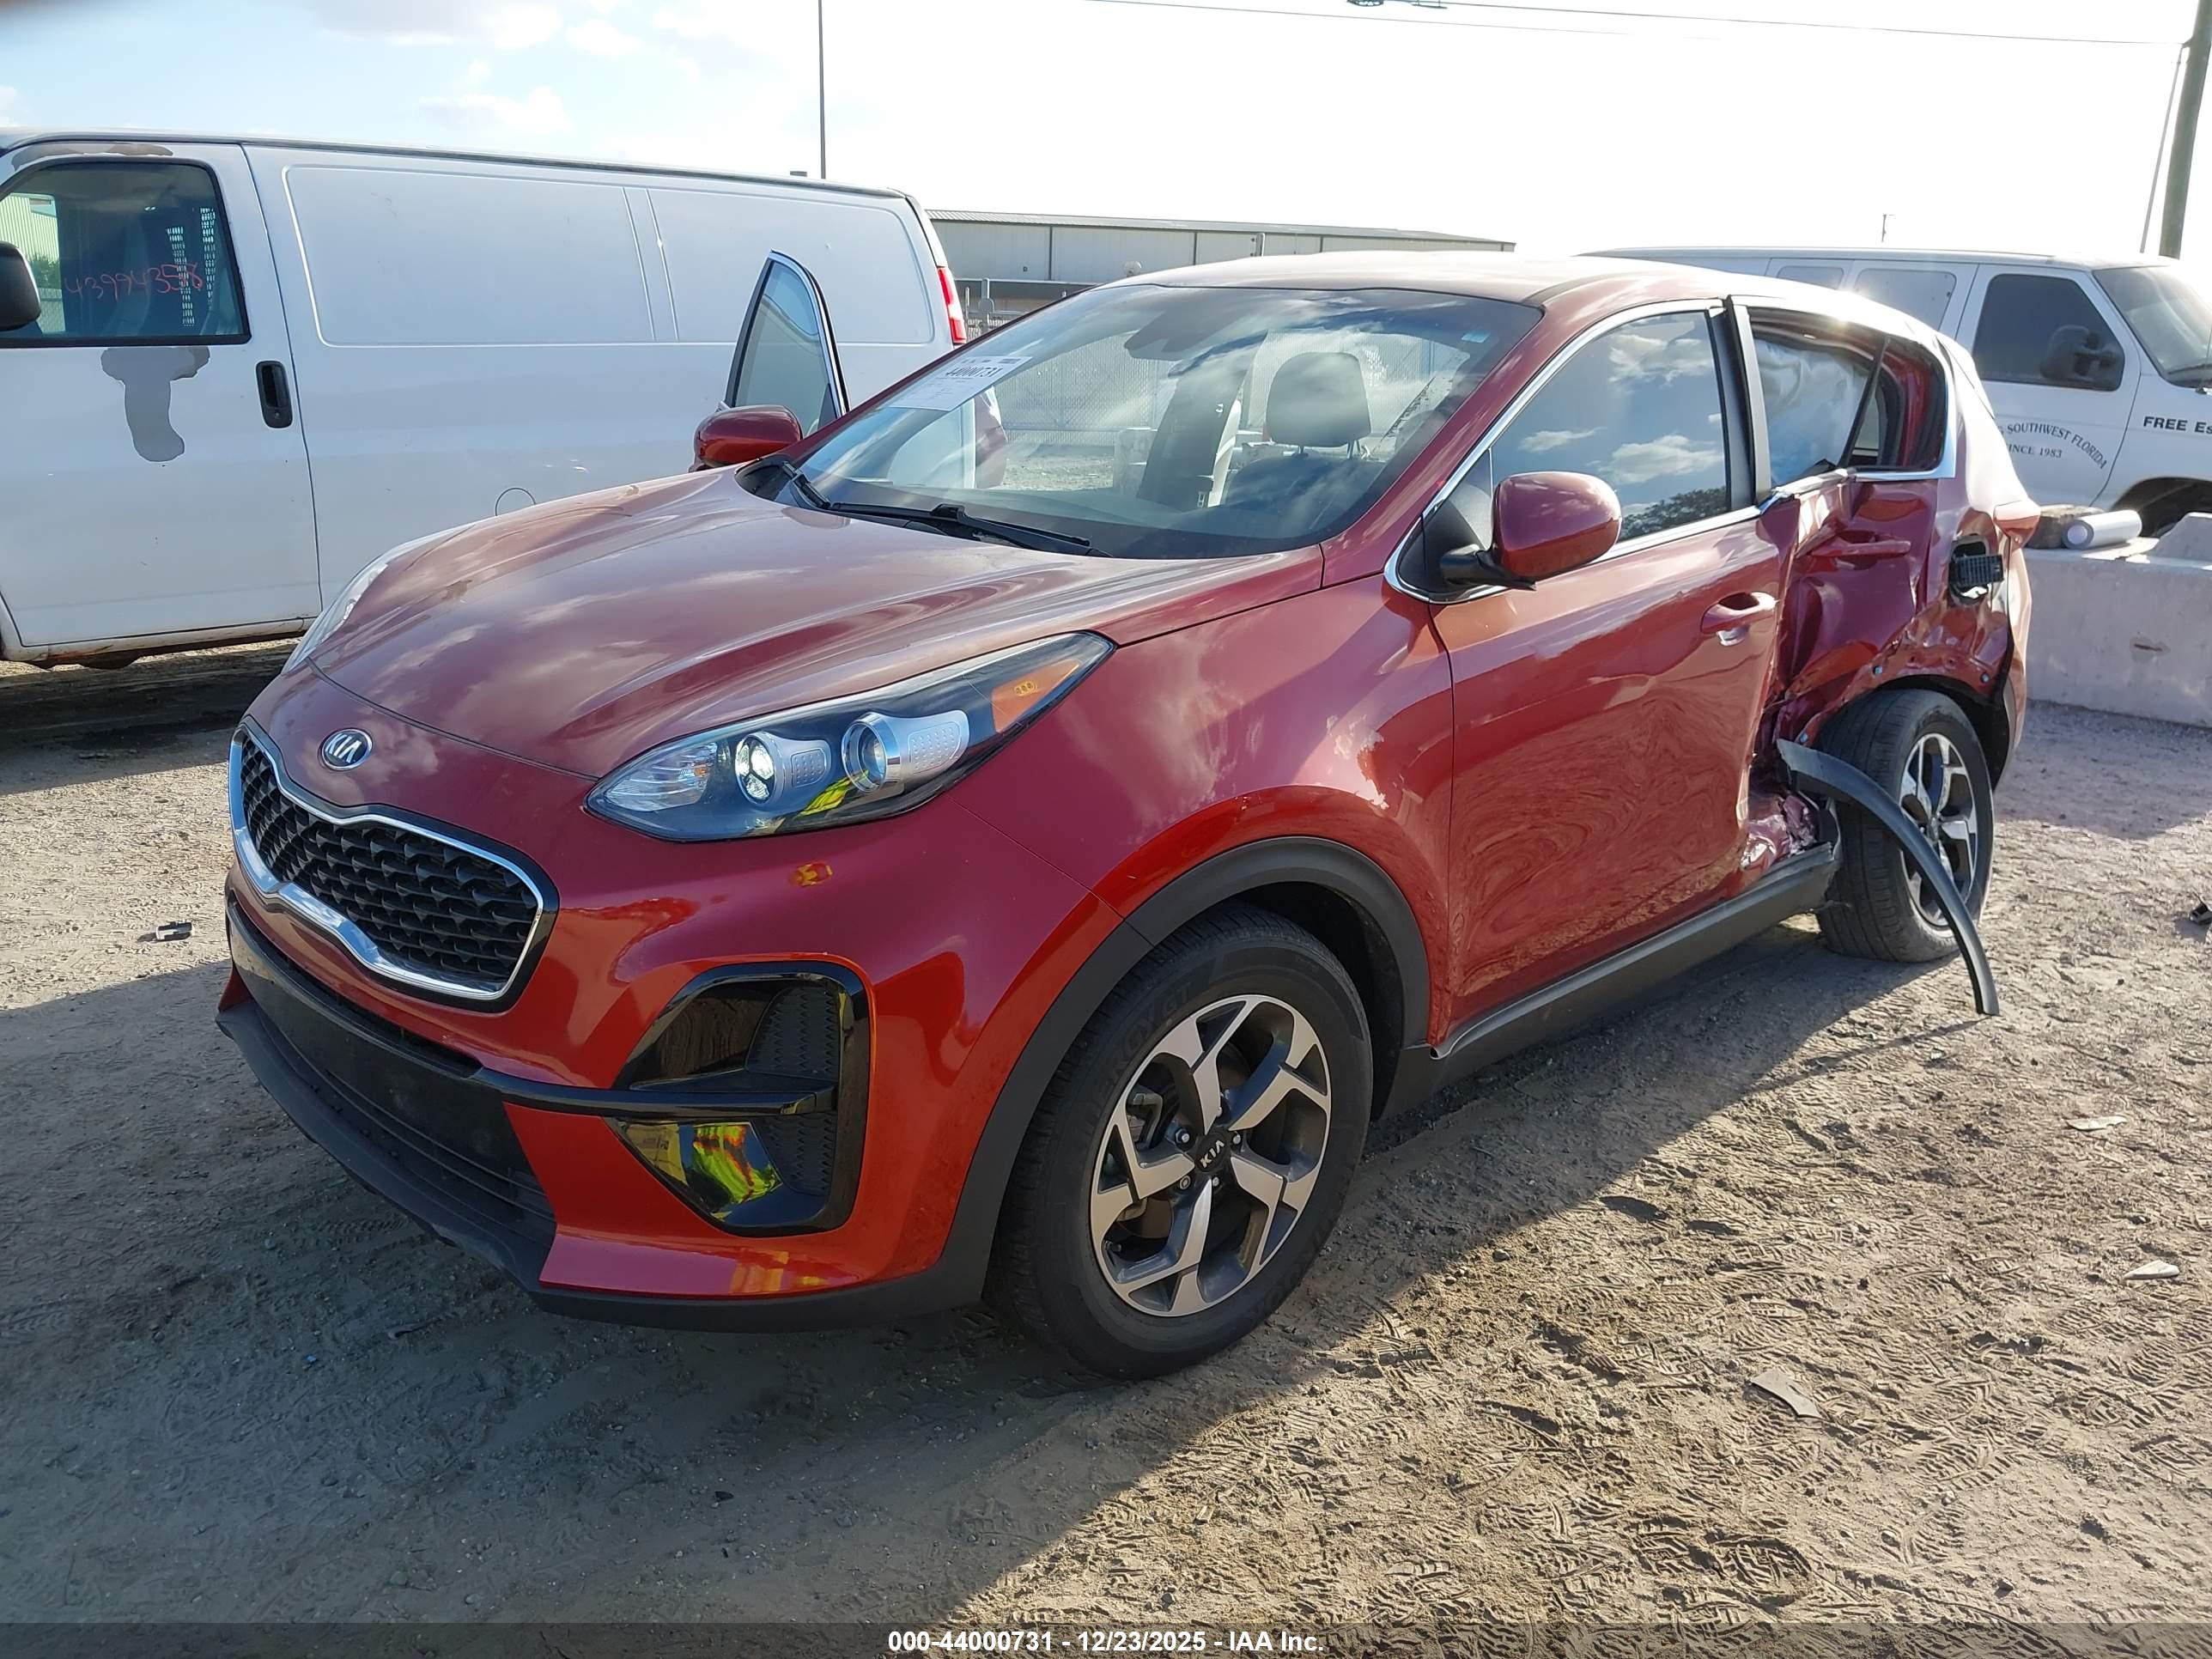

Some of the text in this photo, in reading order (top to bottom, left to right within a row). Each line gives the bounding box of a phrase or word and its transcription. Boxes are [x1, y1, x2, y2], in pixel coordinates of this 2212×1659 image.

[2143, 416, 2188, 431] FREE
[2008, 422, 2107, 469] SOUTHWEST FLORIDA
[2008, 444, 2062, 458] INCE 1983
[1200, 1139, 1225, 1169] KIA
